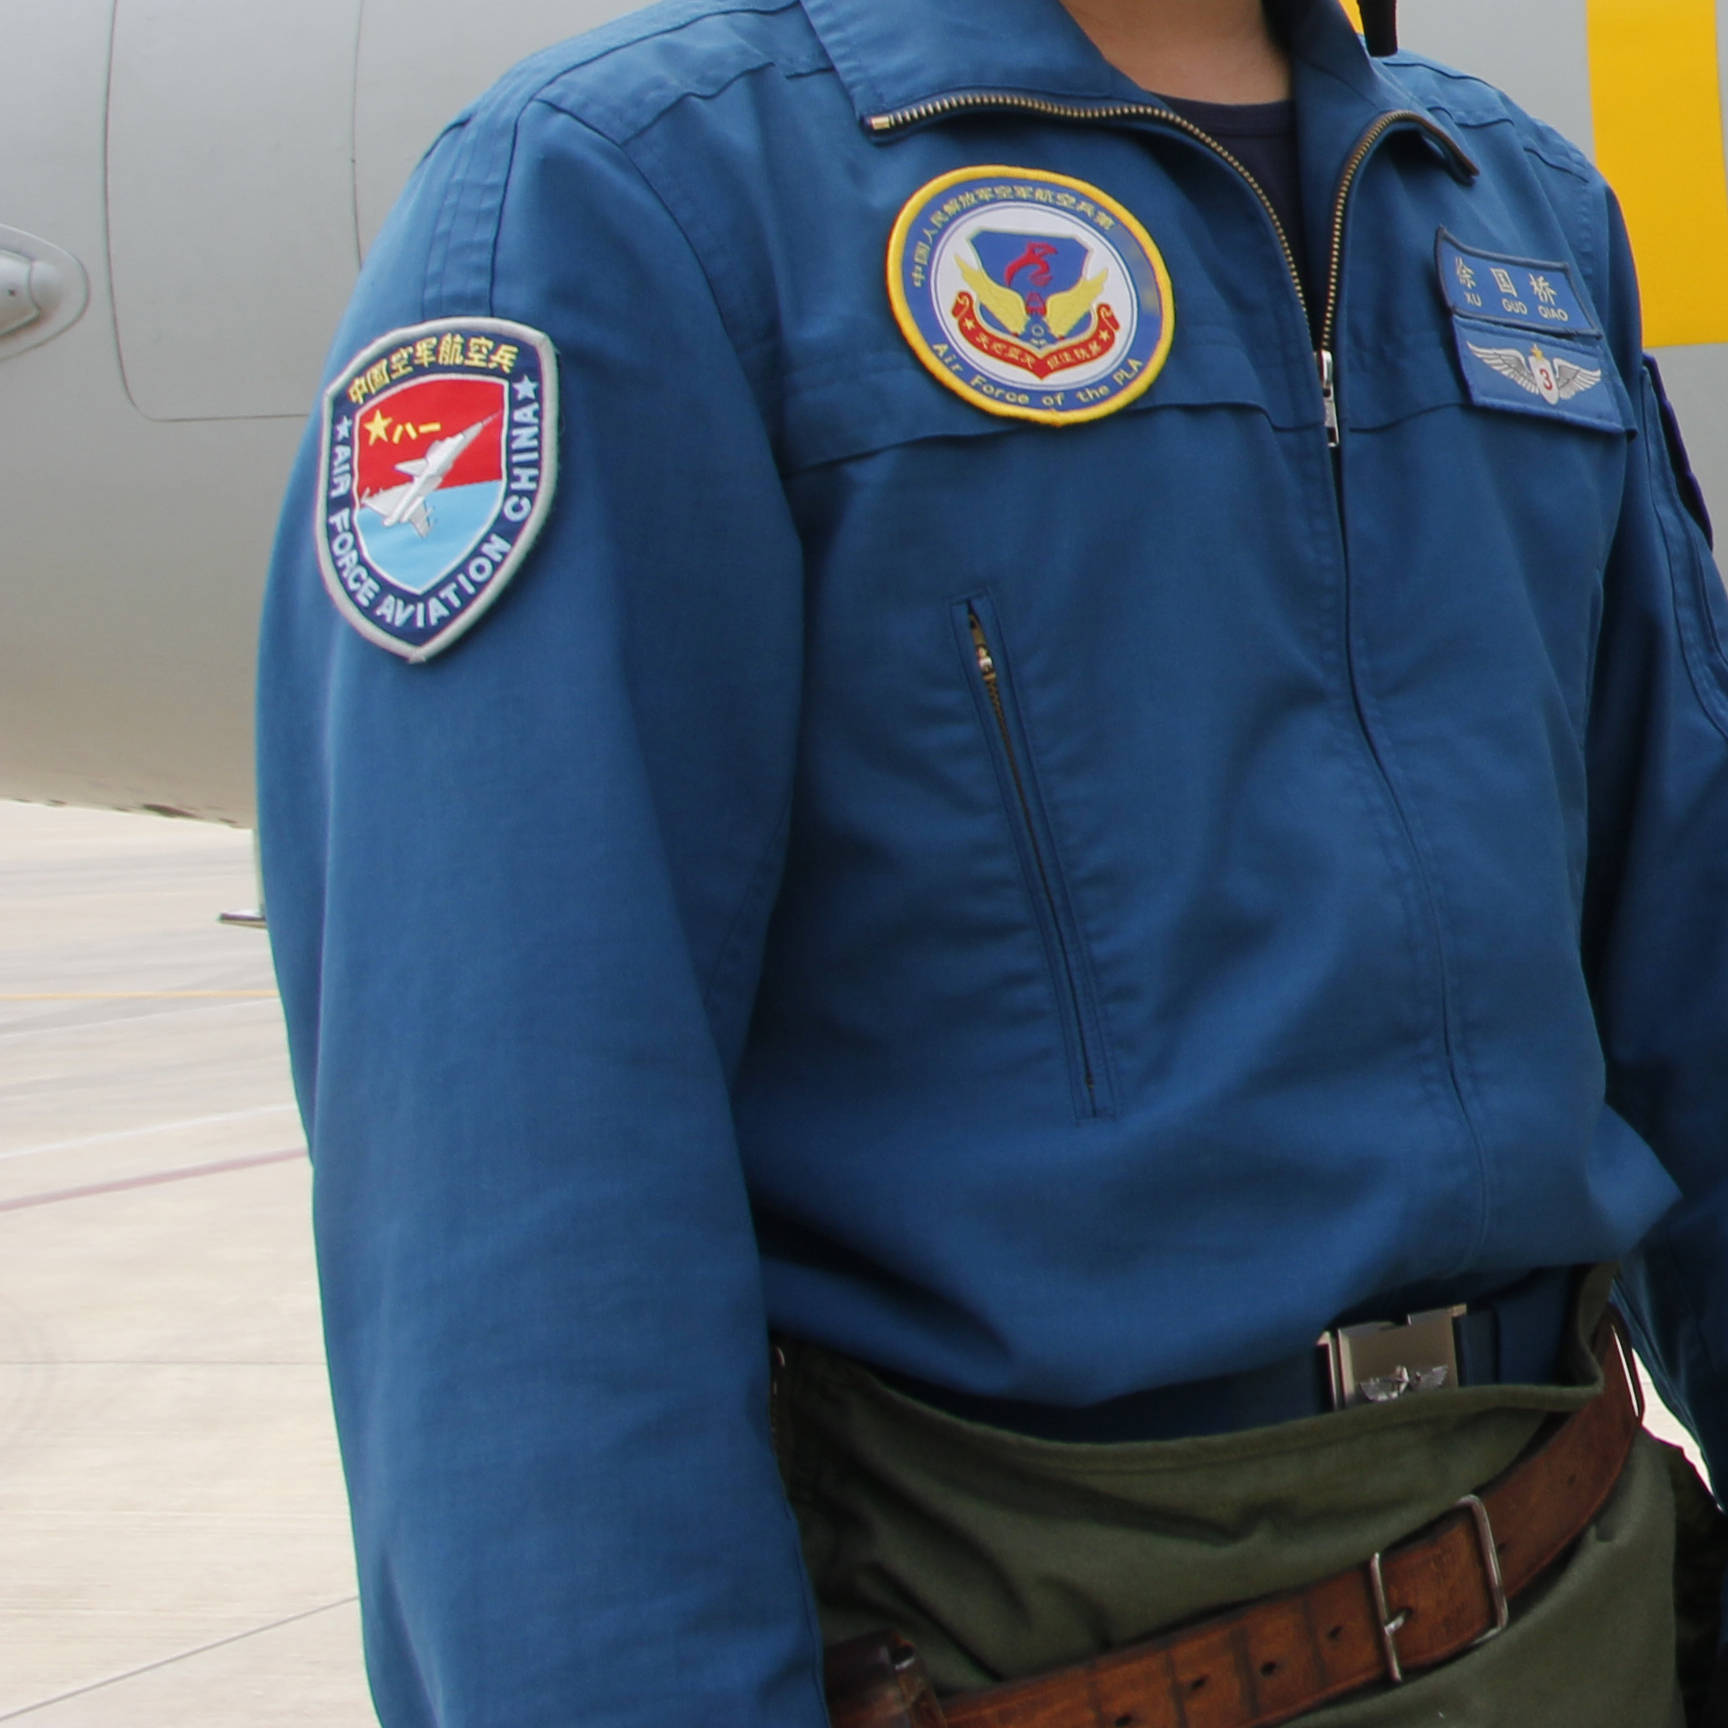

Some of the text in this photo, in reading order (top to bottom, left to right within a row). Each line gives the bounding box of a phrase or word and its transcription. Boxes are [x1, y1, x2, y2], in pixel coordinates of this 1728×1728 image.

[1464, 291, 1569, 322] XU GUO QIAO
[347, 332, 520, 405] 中国空军航空兵
[932, 342, 964, 374] Air
[970, 377, 1030, 406] Force
[1042, 391, 1066, 407] of
[1076, 385, 1110, 403] the
[1113, 357, 1143, 387] PLA
[1539, 368, 1554, 391] 3
[391, 421, 442, 444] 八一
[328, 405, 540, 628] AIR FORCE AVIATION CHINA
